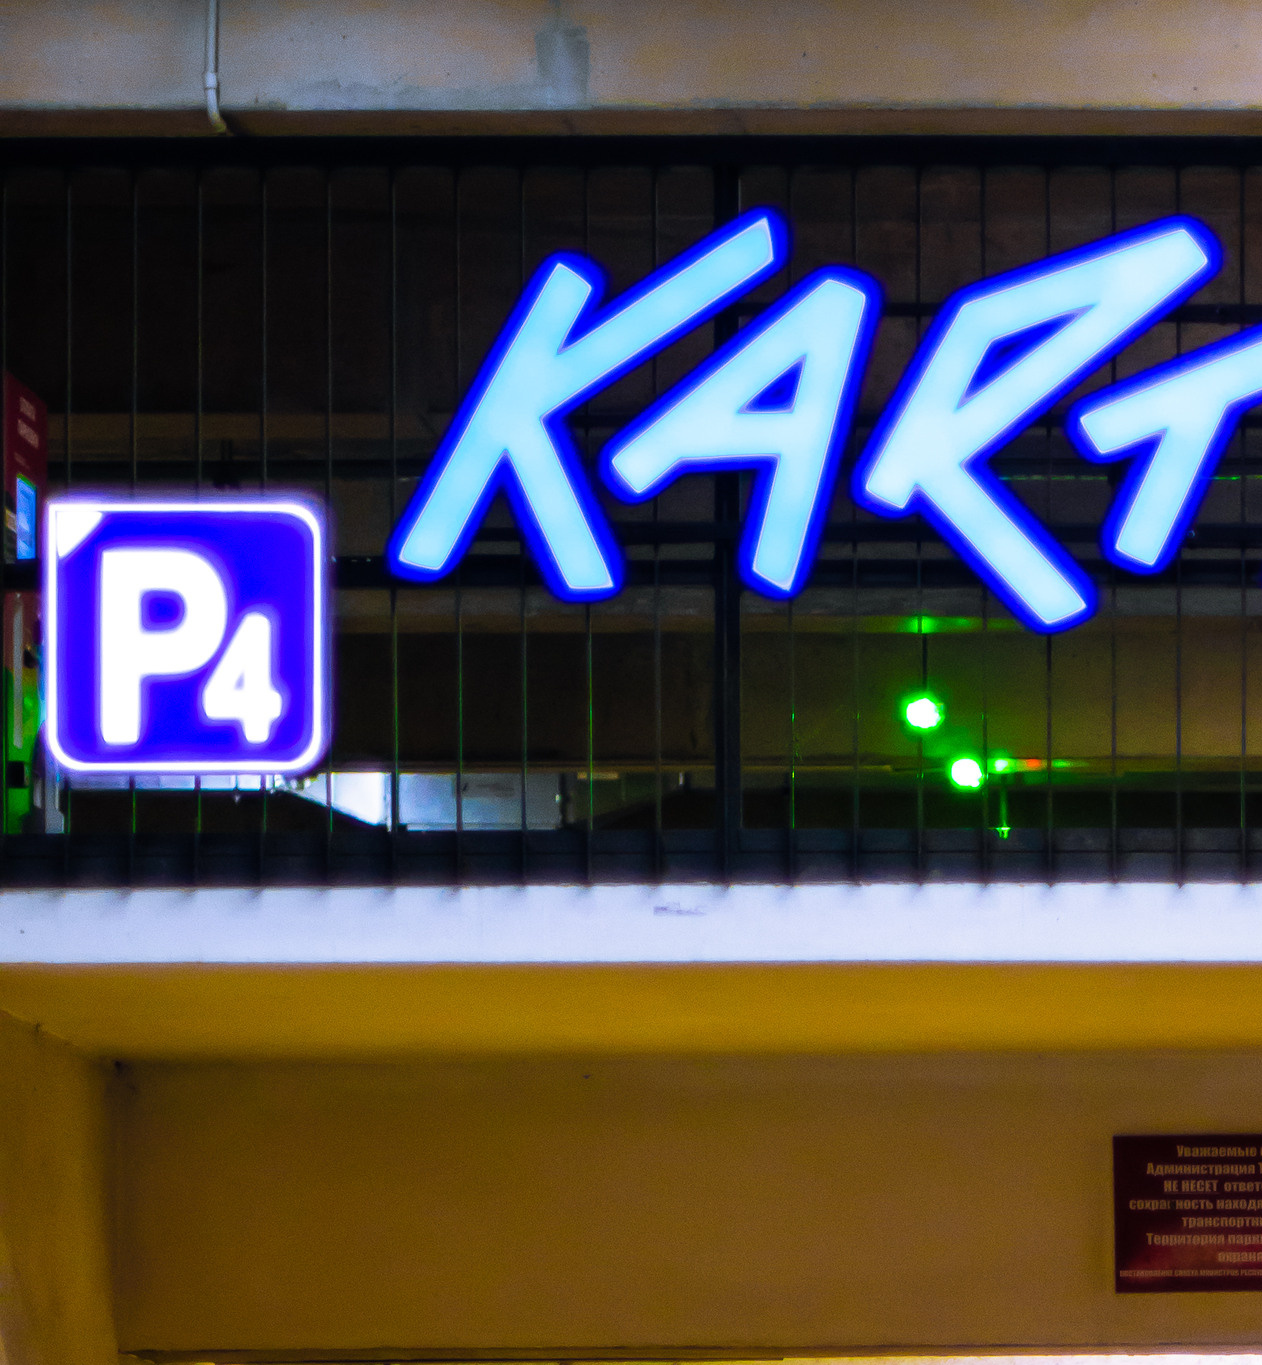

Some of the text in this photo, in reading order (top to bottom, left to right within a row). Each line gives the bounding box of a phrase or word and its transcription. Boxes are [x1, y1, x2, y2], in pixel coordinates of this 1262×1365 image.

[100, 548, 283, 744] P4
[1176, 1145, 1257, 1157] Уважаемые
[1146, 1162, 1256, 1176] Администрация
[1163, 1180, 1179, 1192] НЕ
[1181, 1180, 1219, 1192] НЕСЕТ
[1146, 1232, 1225, 1246] Территория
